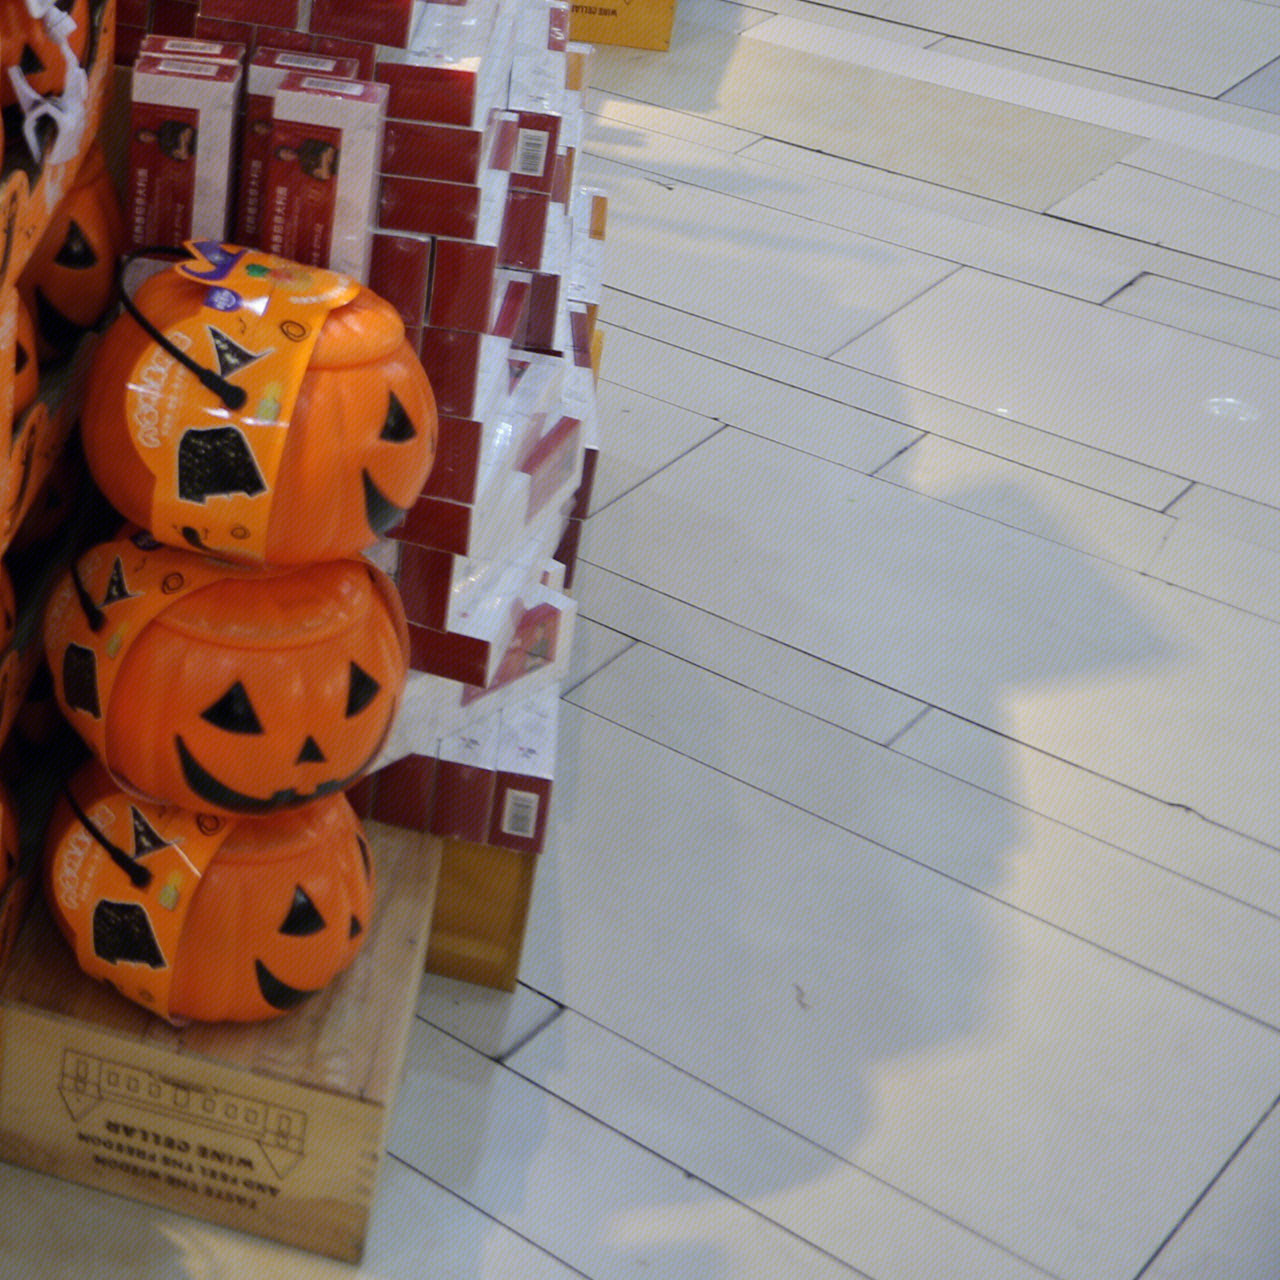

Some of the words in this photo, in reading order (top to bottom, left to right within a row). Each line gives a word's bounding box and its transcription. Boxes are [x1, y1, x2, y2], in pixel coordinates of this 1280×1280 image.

[78, 1131, 157, 1162] FREEDOM
[105, 1120, 190, 1152] CELLAR
[161, 1155, 194, 1173] THE
[198, 1144, 254, 1170] WINE
[167, 1174, 199, 1193] THE
[200, 1166, 238, 1185] FEEL
[205, 1186, 257, 1209] TASTE
[243, 1178, 280, 1197] AND
